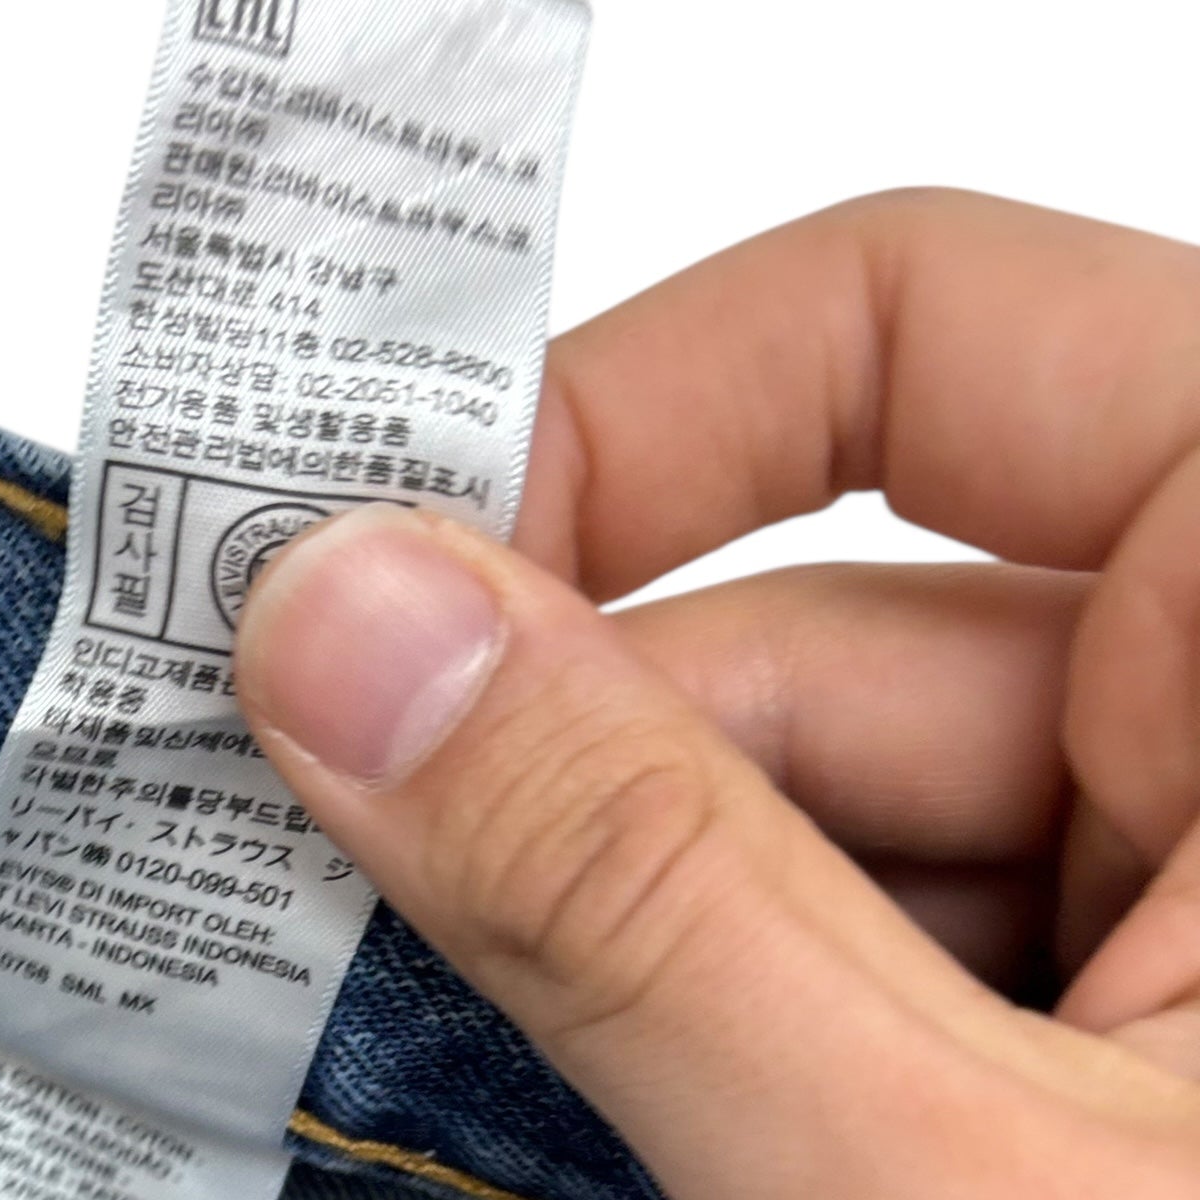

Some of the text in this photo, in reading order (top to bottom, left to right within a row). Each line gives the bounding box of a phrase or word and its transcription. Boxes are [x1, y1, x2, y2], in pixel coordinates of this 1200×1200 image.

[268, 291, 322, 320] 414
[19, 762, 327, 834] 각별한주의를당부드립
[12, 890, 65, 919] LEVI
[68, 904, 179, 950] STRAUSS
[183, 935, 313, 987] INDONESIA
[77, 878, 104, 900] DI
[109, 887, 203, 927] IMPORT
[202, 912, 276, 945] OLEH:
[91, 939, 219, 987] INDONESIA
